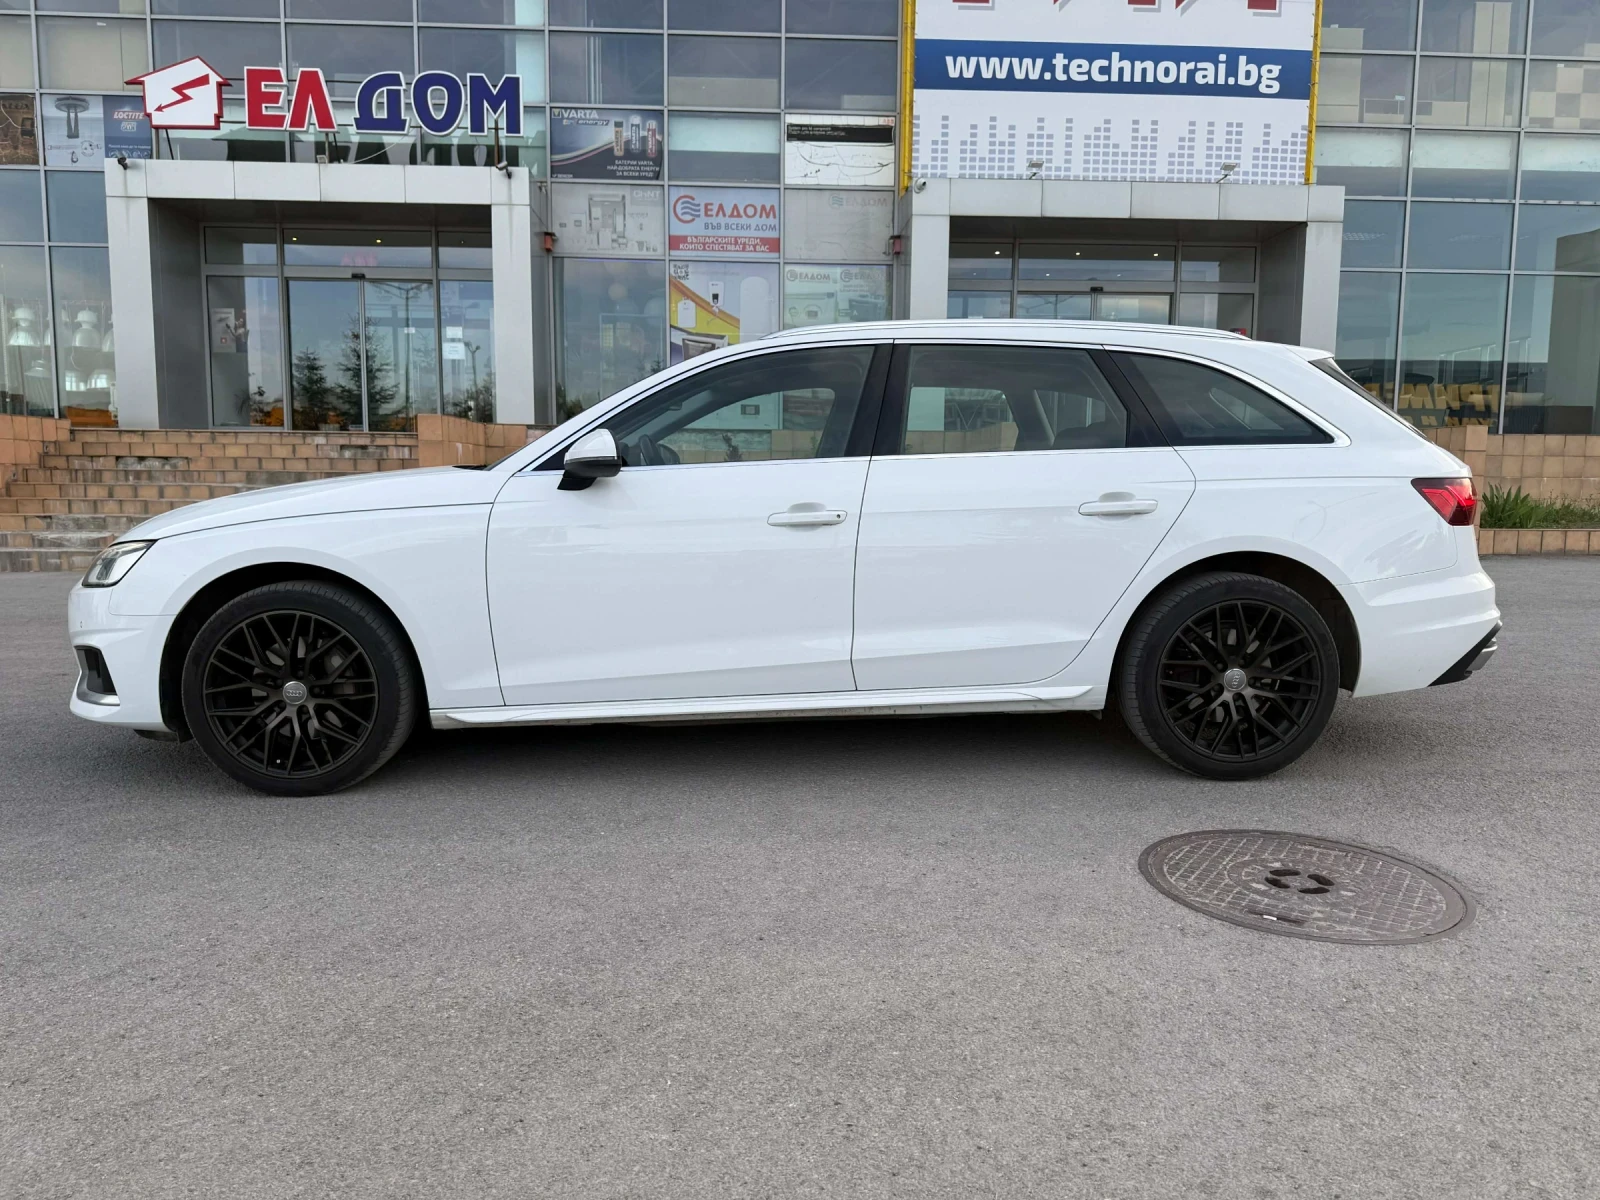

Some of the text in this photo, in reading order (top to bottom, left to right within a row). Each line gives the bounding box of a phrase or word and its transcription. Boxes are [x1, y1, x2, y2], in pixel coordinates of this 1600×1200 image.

[945, 51, 1282, 94] www.technorai.bg
[244, 66, 524, 137] ЕЛ ДОМ
[113, 111, 144, 119] LOCTITE
[562, 109, 599, 119] VARTA
[704, 203, 777, 219] ЕЛДОМ
[704, 222, 777, 232] ВЪВ ВСЕКИ ДОМ
[799, 272, 831, 281] ЕЛДОМ
